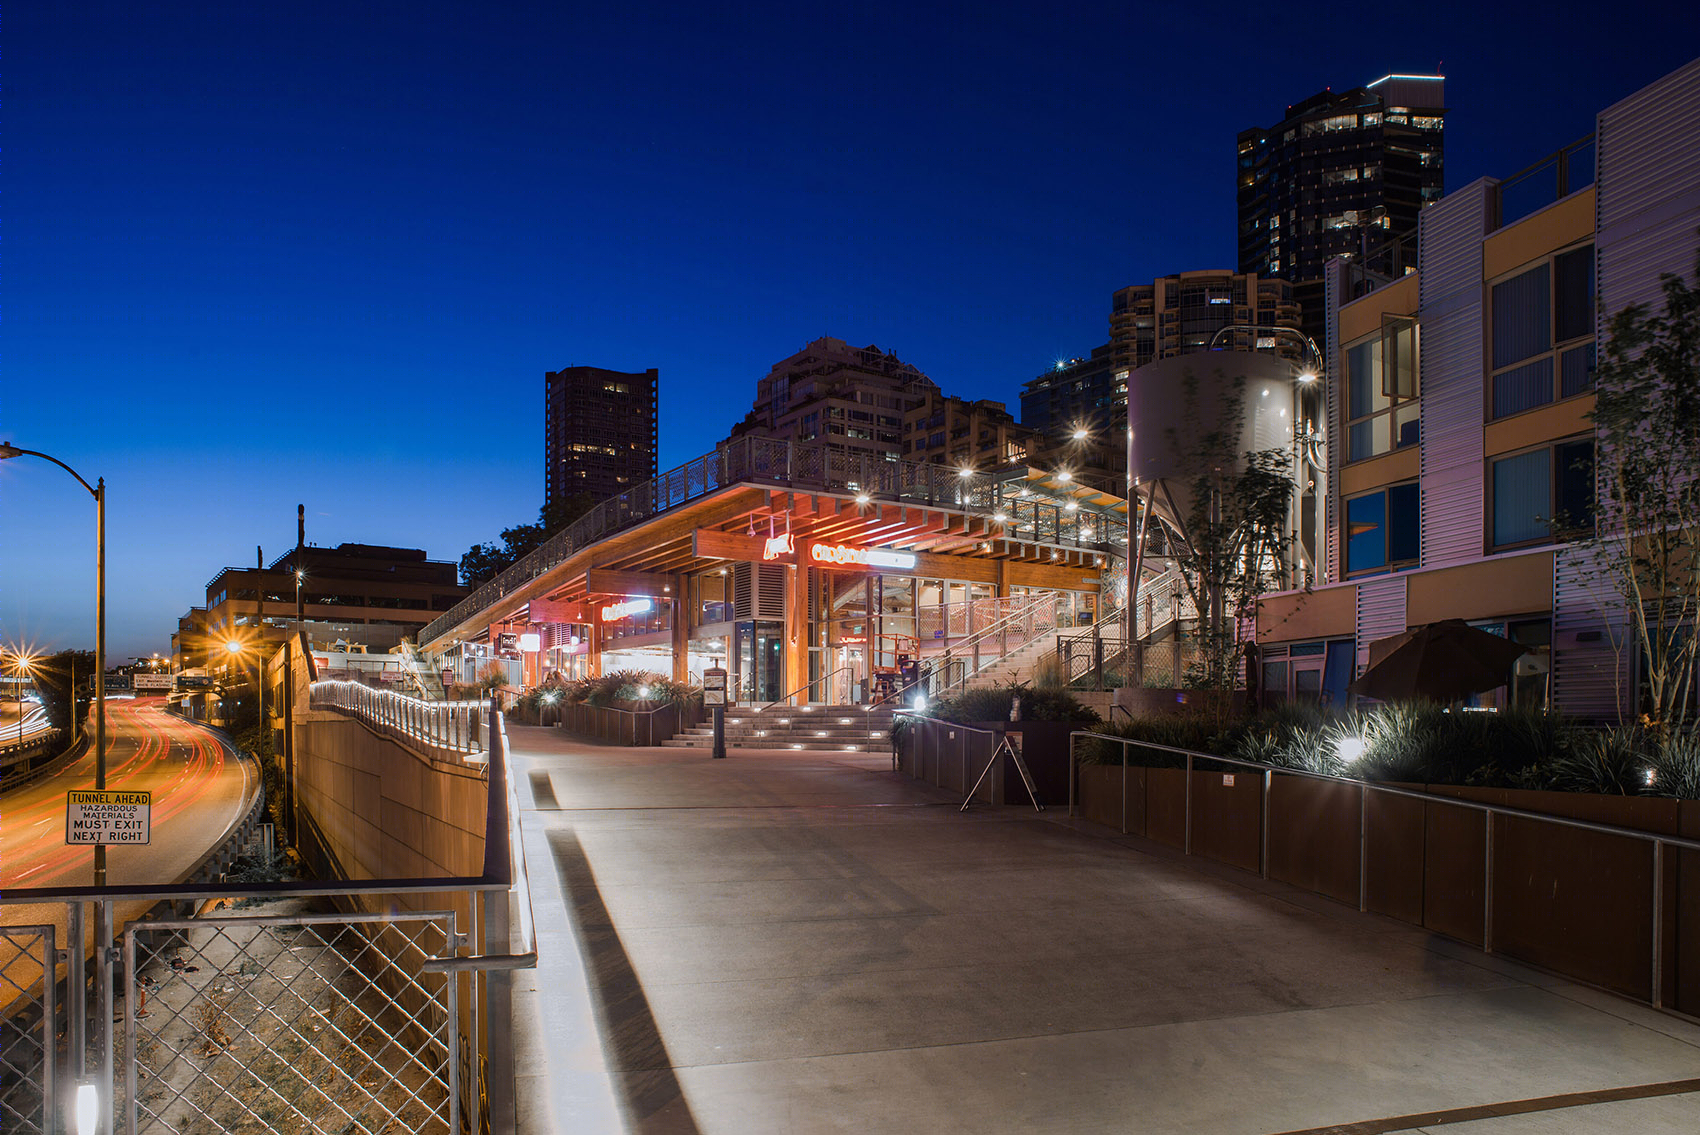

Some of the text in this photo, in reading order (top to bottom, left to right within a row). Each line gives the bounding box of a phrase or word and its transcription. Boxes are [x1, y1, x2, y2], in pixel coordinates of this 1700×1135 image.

[72, 794, 148, 804] TUNNEL AHEAD
[74, 820, 143, 829] MUST EXIT
[74, 832, 142, 840] NEXT RIGHT
